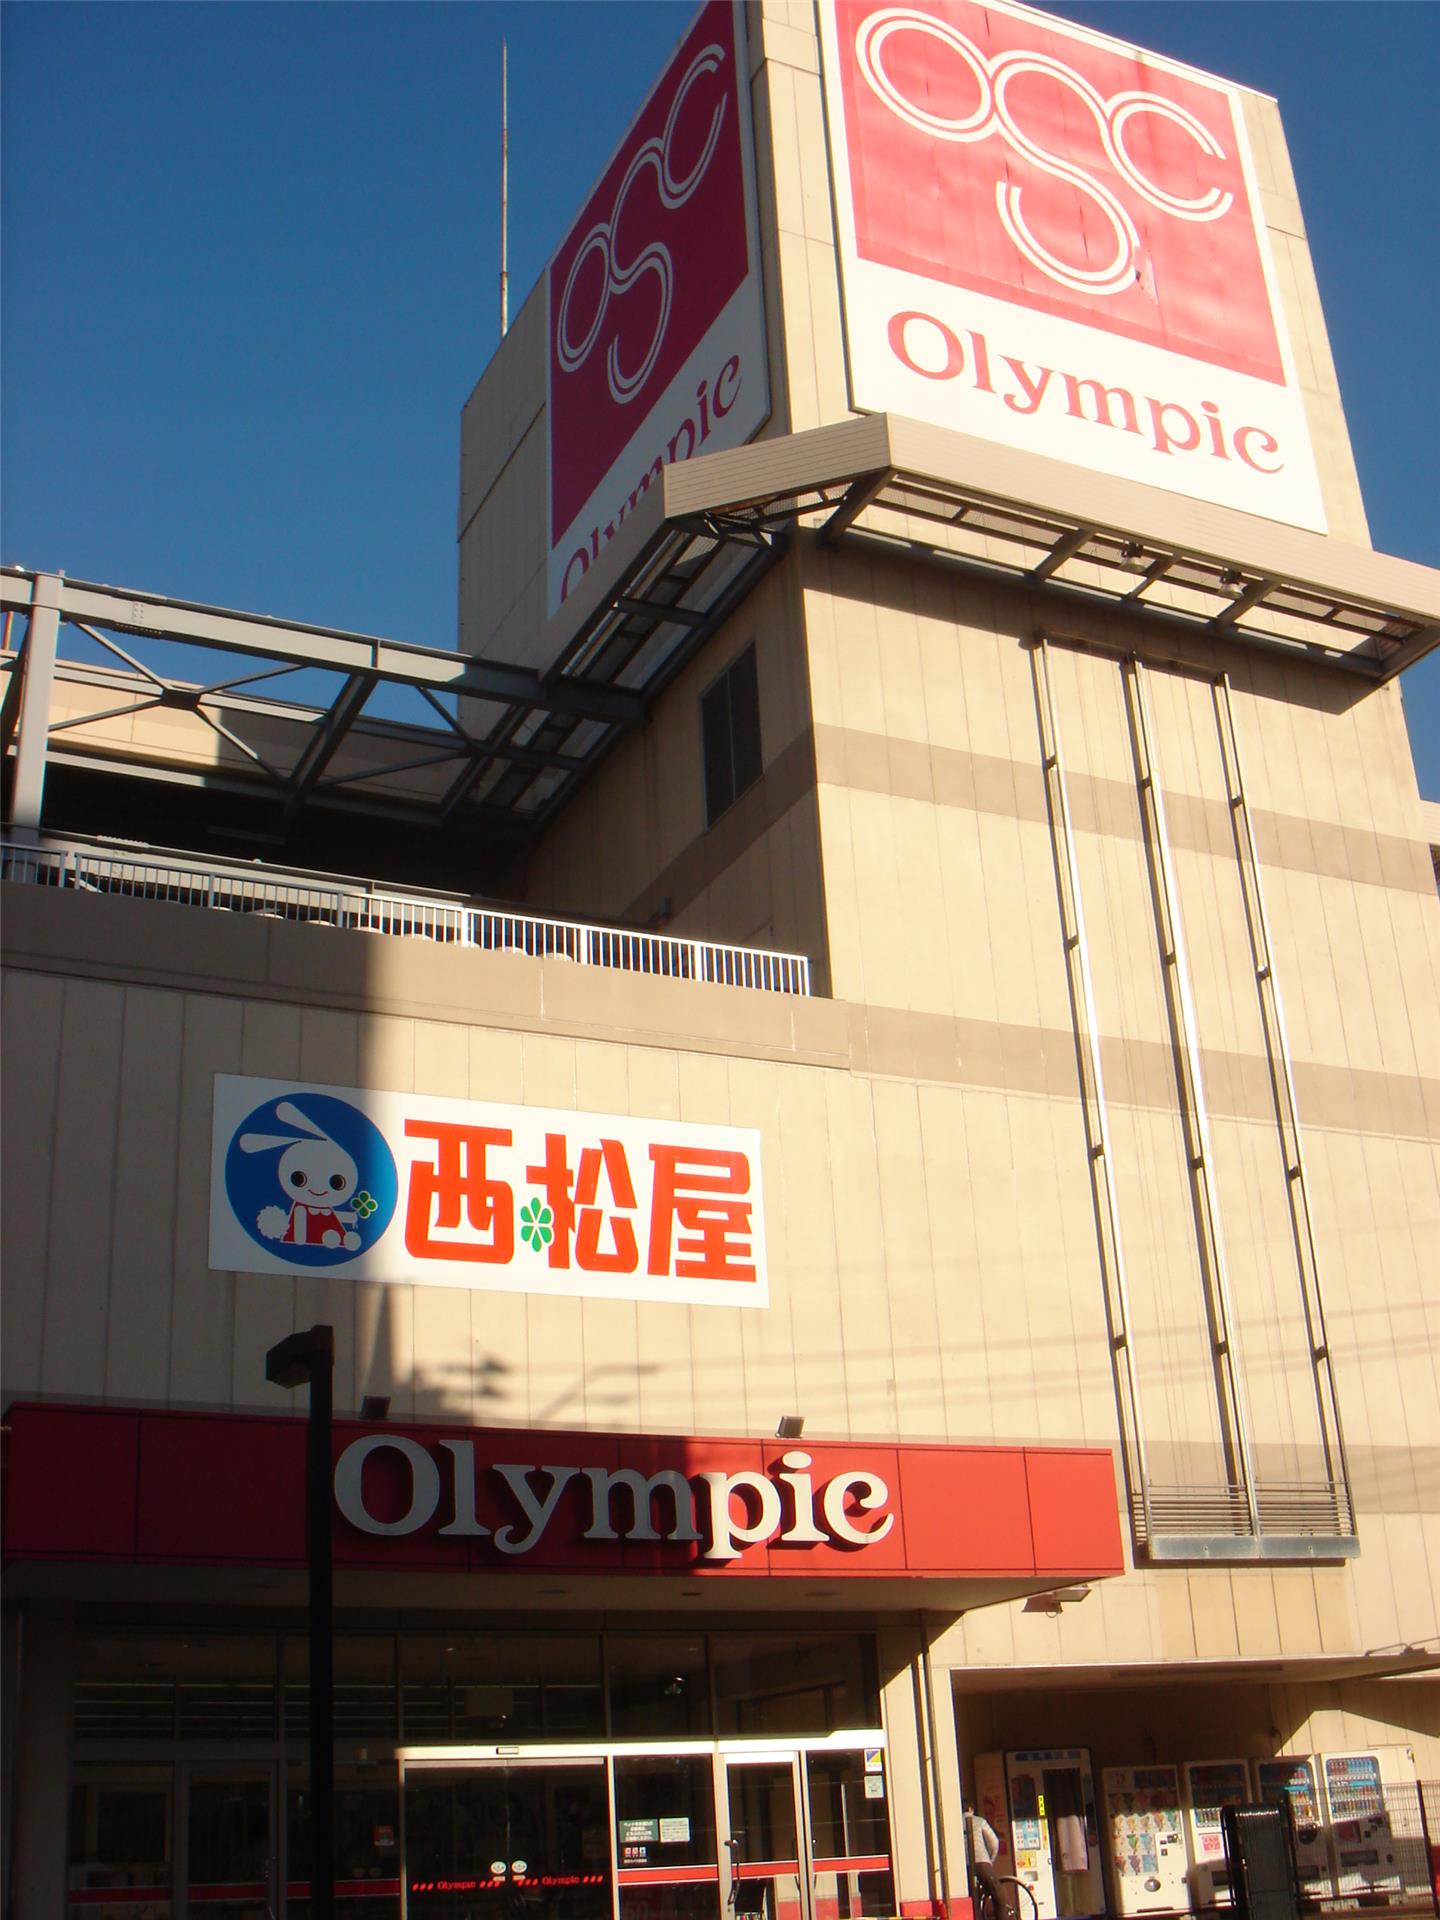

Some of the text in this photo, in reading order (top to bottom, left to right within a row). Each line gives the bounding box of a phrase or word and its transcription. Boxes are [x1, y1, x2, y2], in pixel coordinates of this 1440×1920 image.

[557, 43, 727, 404] OSC
[855, 8, 1234, 295] OSC
[887, 311, 1284, 473] Olympic
[405, 1118, 757, 1282] 西松屋
[334, 1434, 894, 1559] Olympic
[437, 1880, 476, 1890] Olympic
[542, 1874, 579, 1885] Olympic
